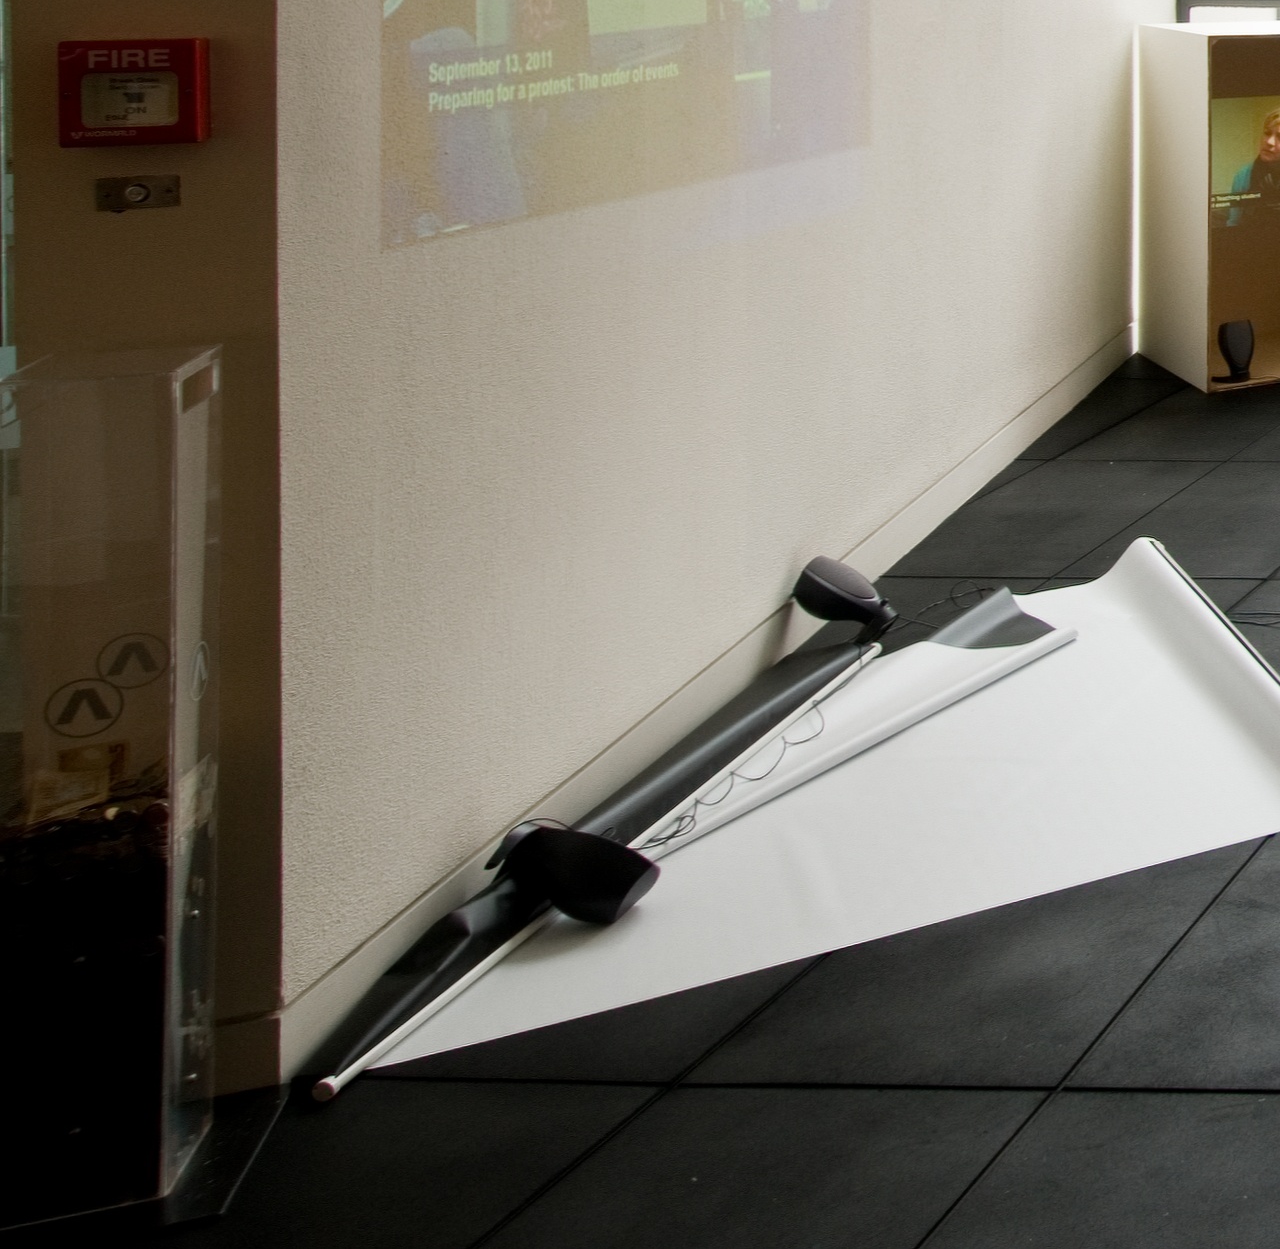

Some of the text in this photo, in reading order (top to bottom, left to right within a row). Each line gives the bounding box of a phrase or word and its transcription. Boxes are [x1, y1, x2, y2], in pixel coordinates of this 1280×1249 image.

[87, 48, 171, 69] FIRE
[428, 50, 552, 86] September 13, 2011
[428, 62, 679, 114] Preparing for a protest: The order of events
[125, 106, 147, 114] ON
